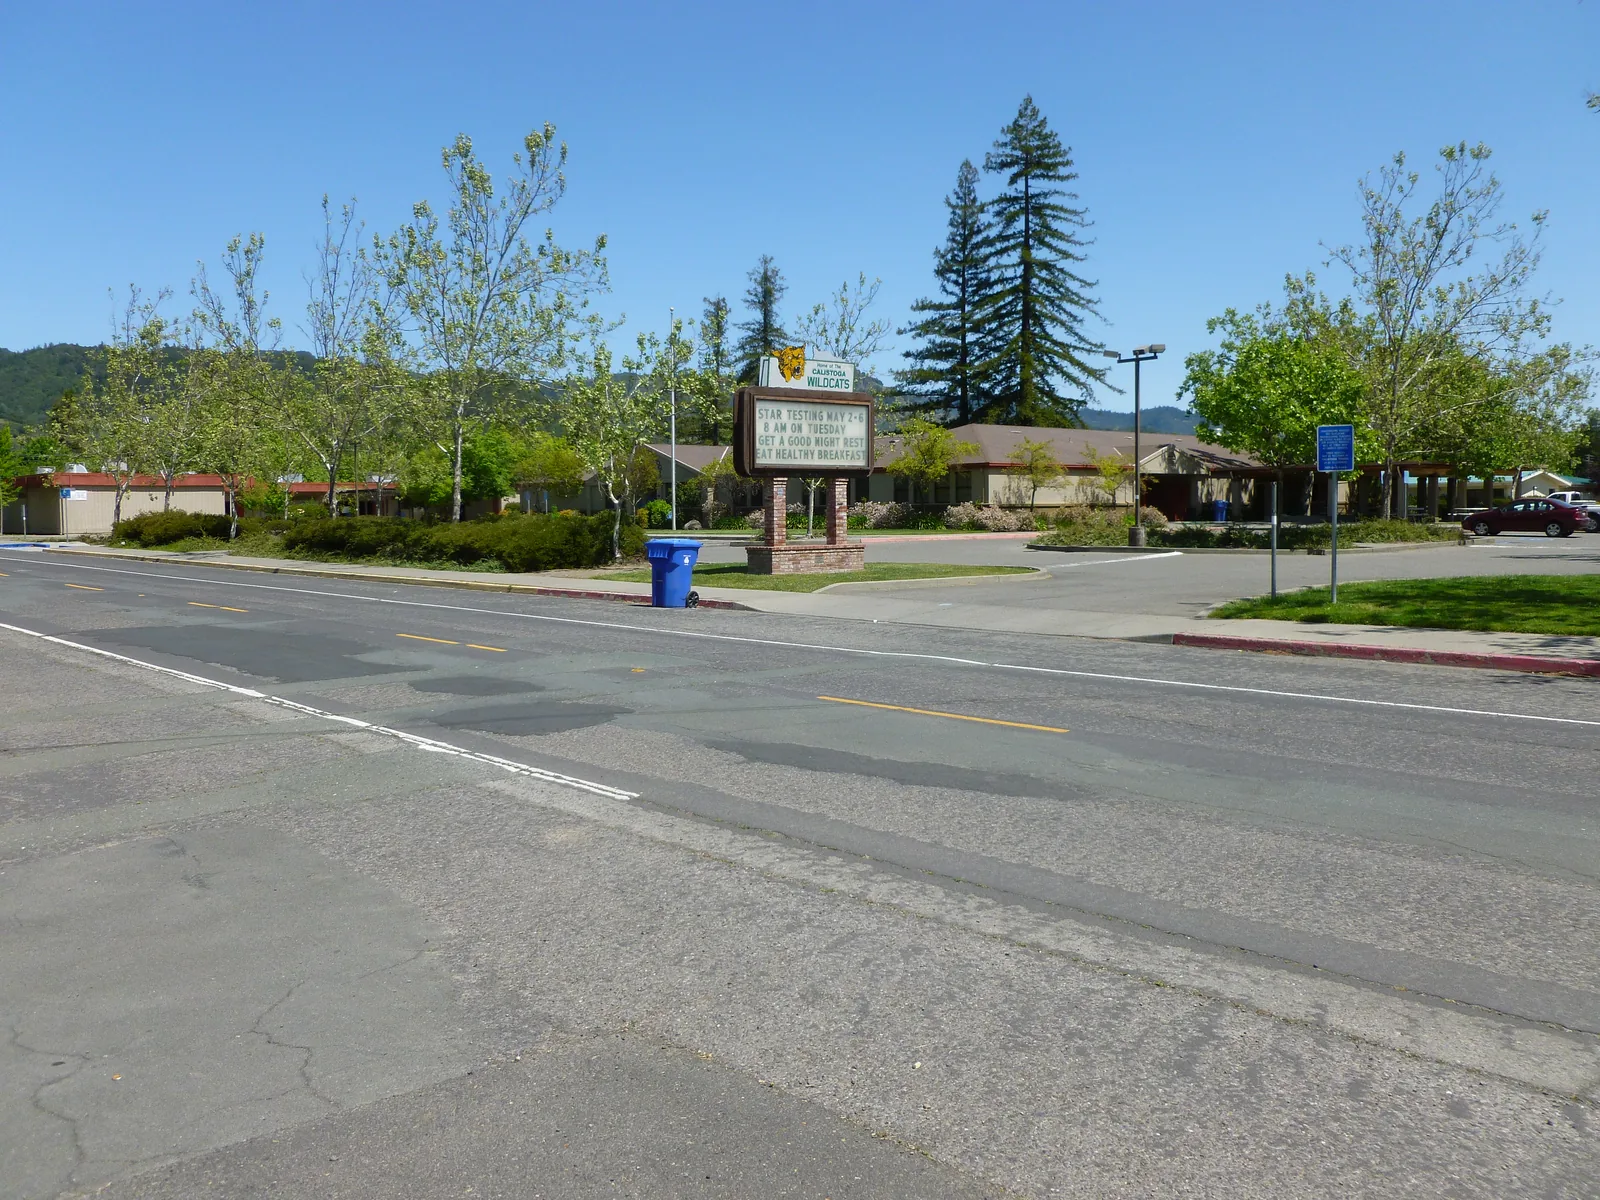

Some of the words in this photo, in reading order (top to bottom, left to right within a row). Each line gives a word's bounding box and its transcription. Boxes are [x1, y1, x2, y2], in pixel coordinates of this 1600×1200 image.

[807, 376, 850, 389] WILDCATS
[758, 409, 782, 419] STAR
[787, 410, 823, 421] TESTING
[827, 411, 845, 422] MAY
[848, 412, 864, 422] 2-6
[764, 422, 768, 432] 8
[774, 422, 786, 433] AM
[791, 423, 802, 433] ON
[808, 424, 846, 434] TUESDAY
[759, 436, 775, 446] GET
[779, 436, 784, 446] A
[788, 437, 811, 446] GOOD
[815, 437, 840, 447] NIGHT
[844, 438, 864, 447] REST
[756, 448, 772, 459] EAT
[776, 449, 815, 459] HEALTHY
[818, 450, 864, 460] BREAKFAST
